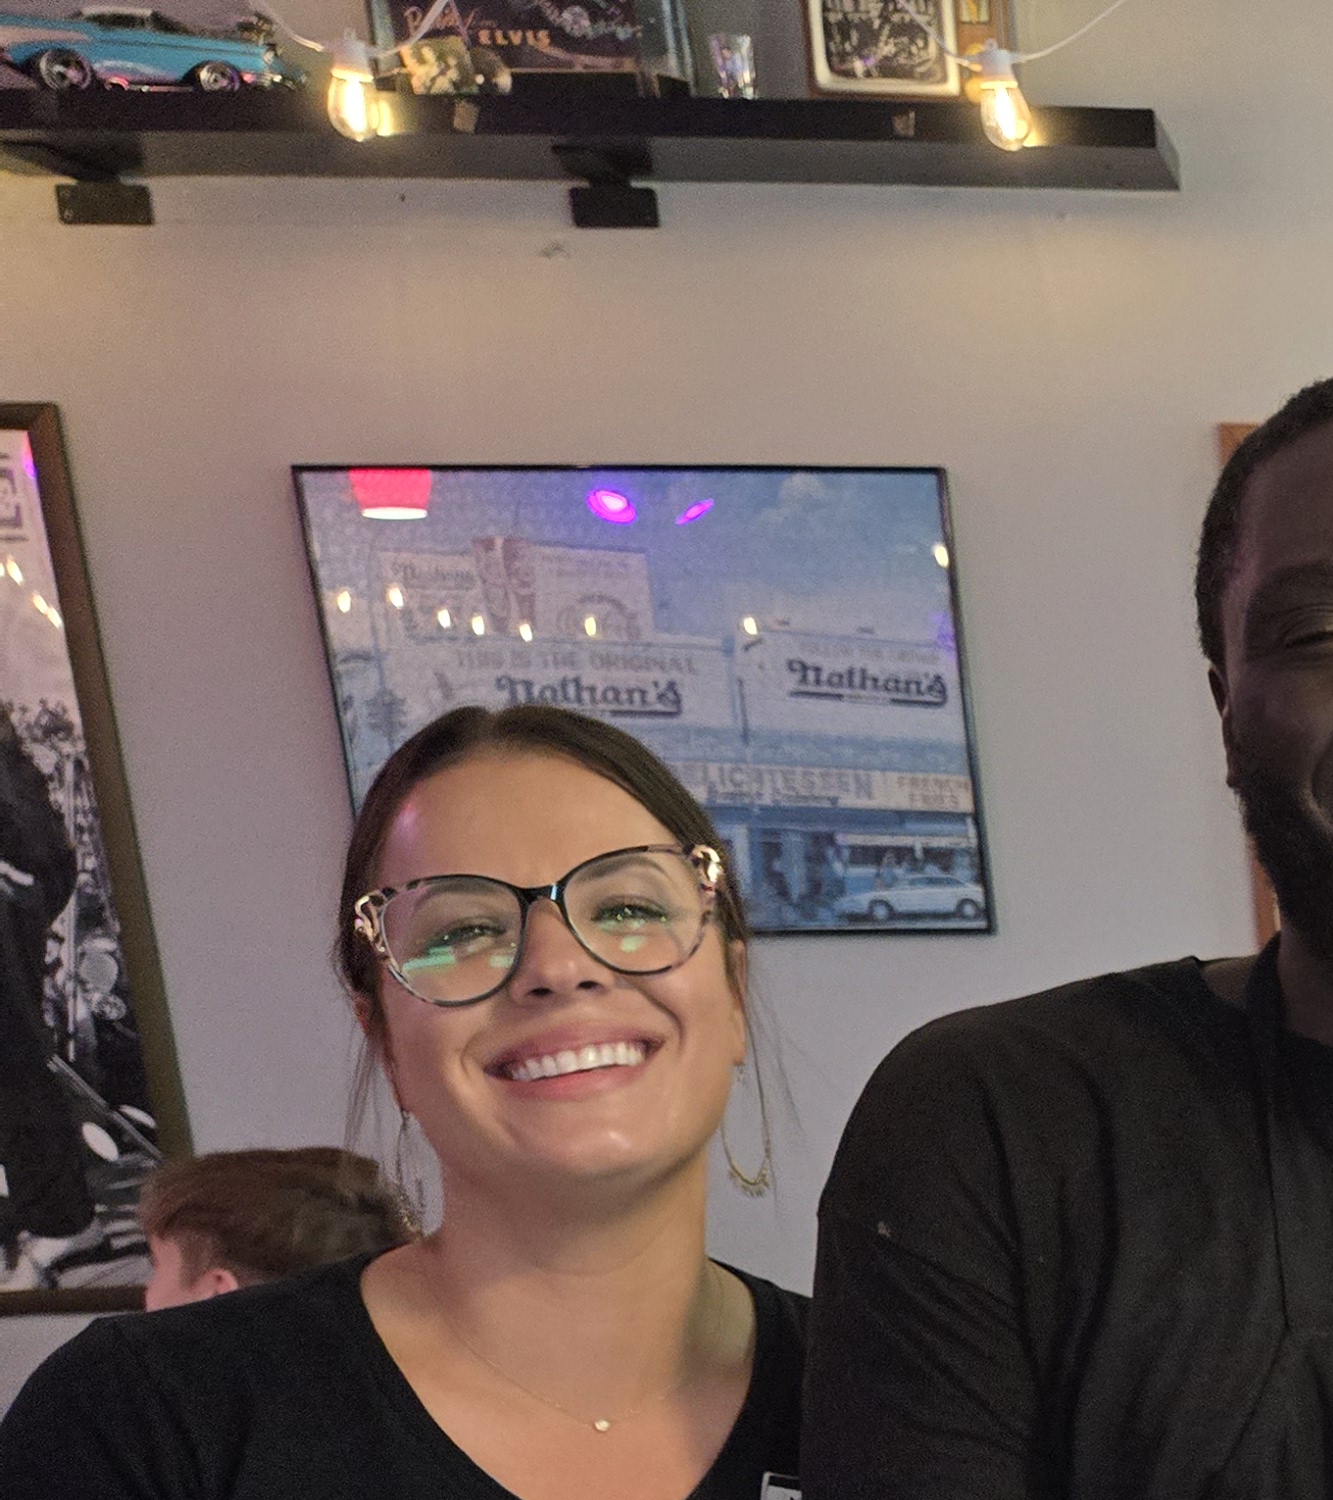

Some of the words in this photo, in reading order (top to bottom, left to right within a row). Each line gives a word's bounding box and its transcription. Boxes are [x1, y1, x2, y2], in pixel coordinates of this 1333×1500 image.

[478, 29, 552, 46] ELVIS
[495, 674, 682, 716] Nathan's
[787, 657, 948, 708] Nathan's
